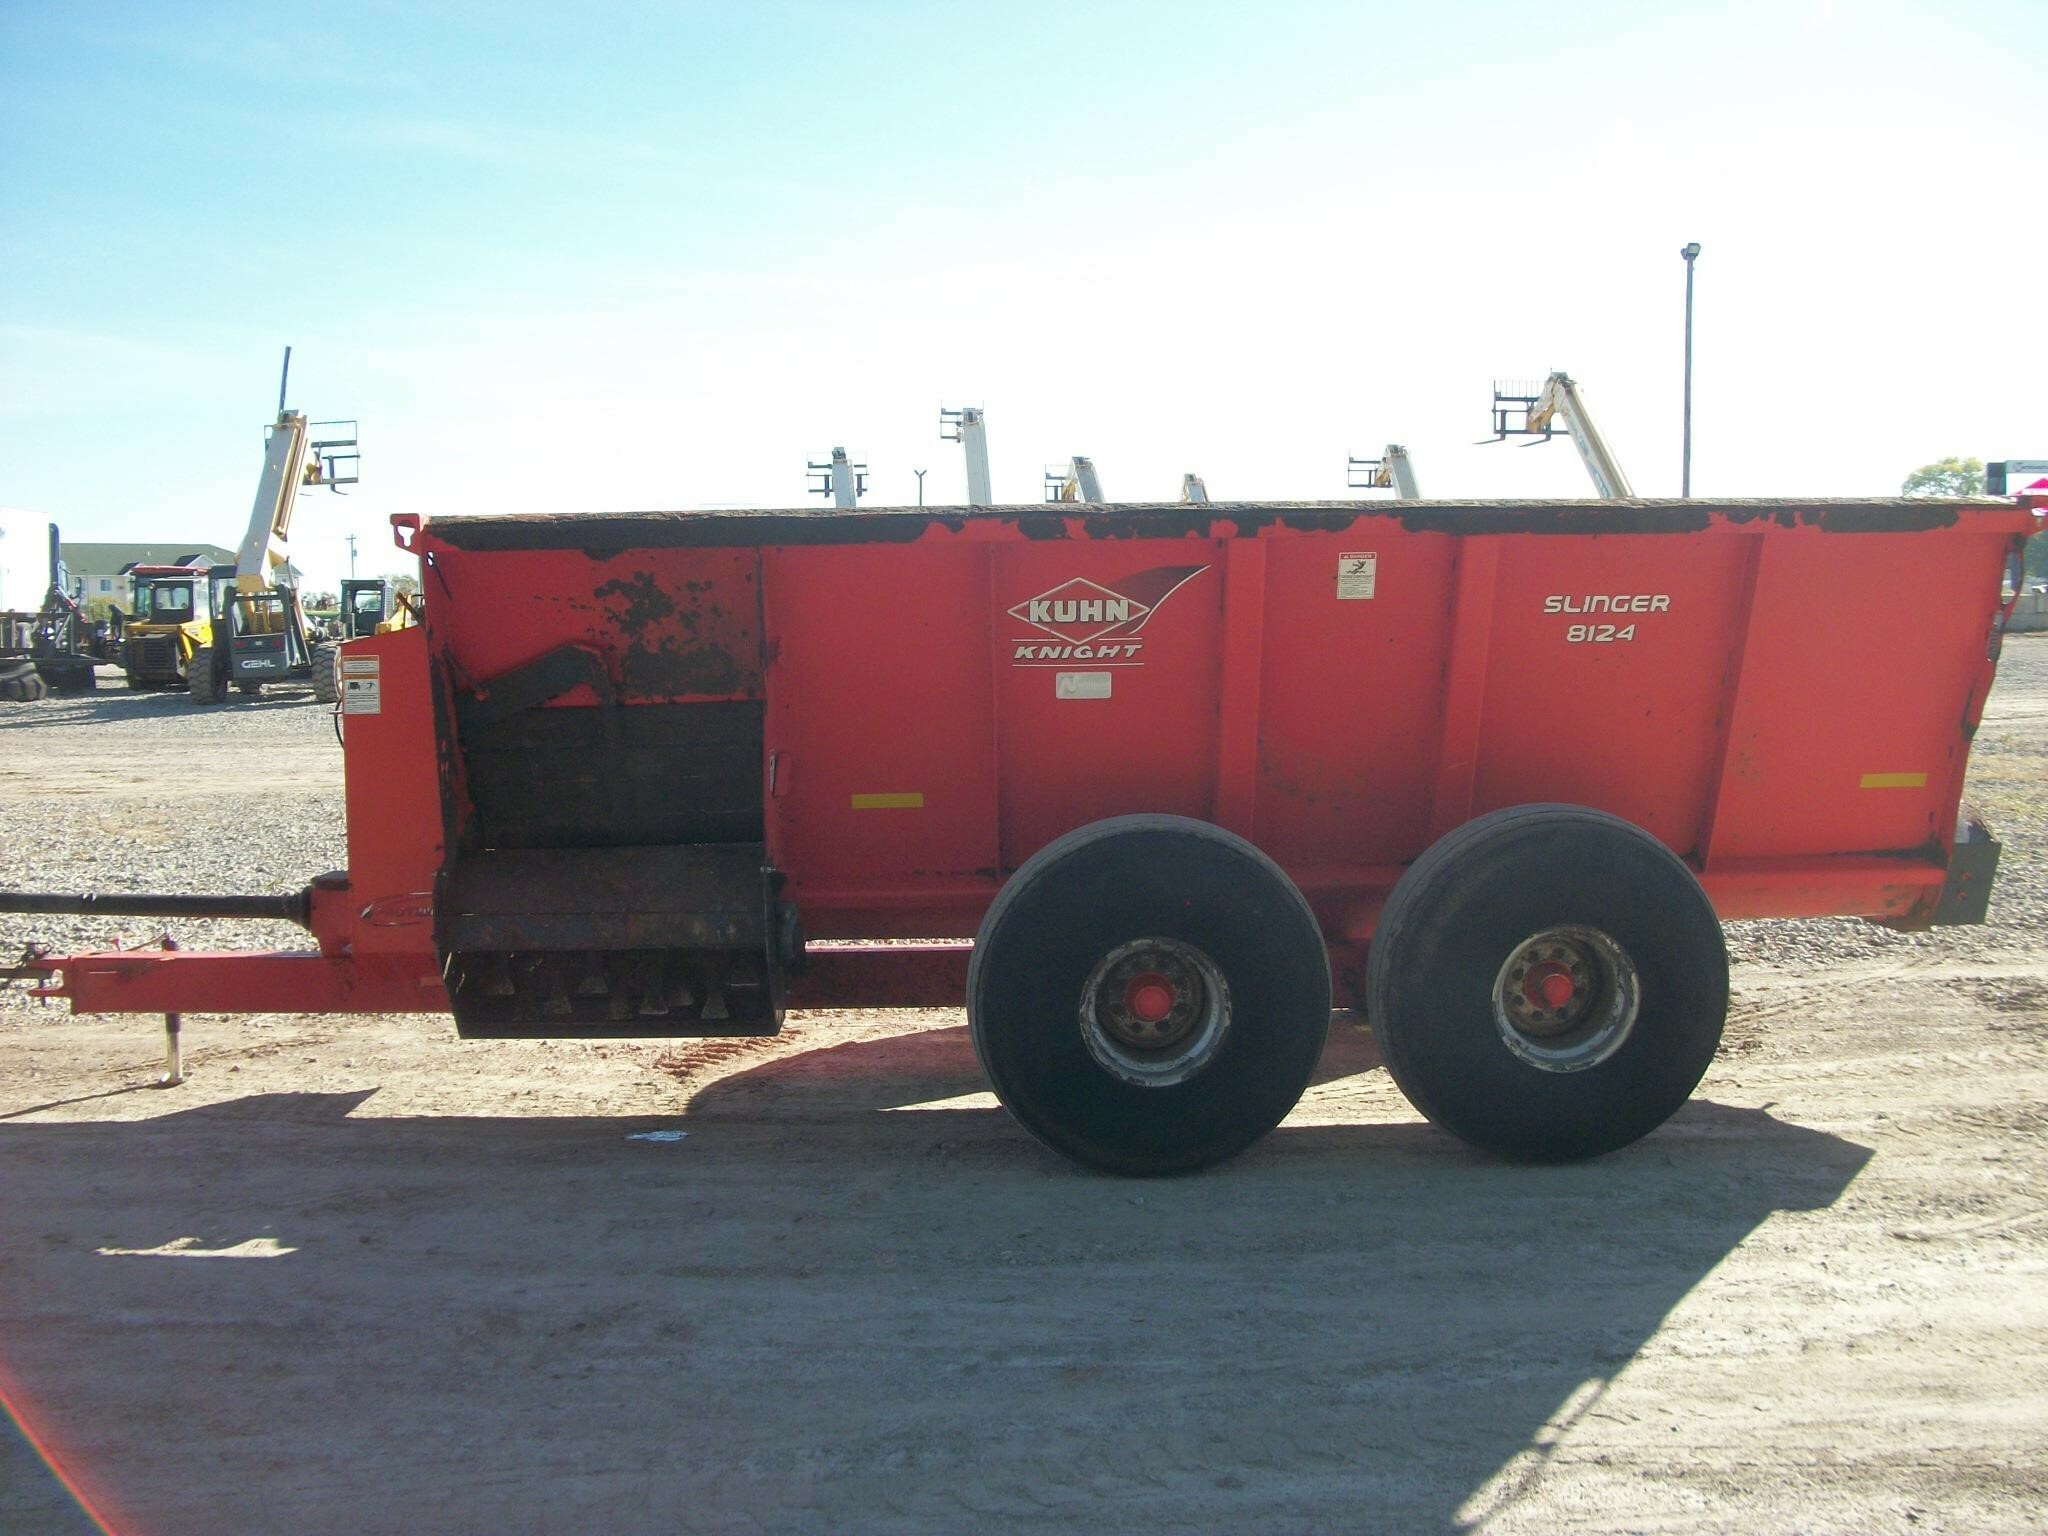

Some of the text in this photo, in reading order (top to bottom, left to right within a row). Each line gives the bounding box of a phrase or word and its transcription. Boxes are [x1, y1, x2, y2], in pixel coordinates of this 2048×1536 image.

[1029, 600, 1129, 623] KUHN
[1543, 595, 1670, 613] SLINGER
[1566, 624, 1636, 642] 8124
[1013, 645, 1143, 659] KNIGHT
[241, 659, 276, 669] GEHL
